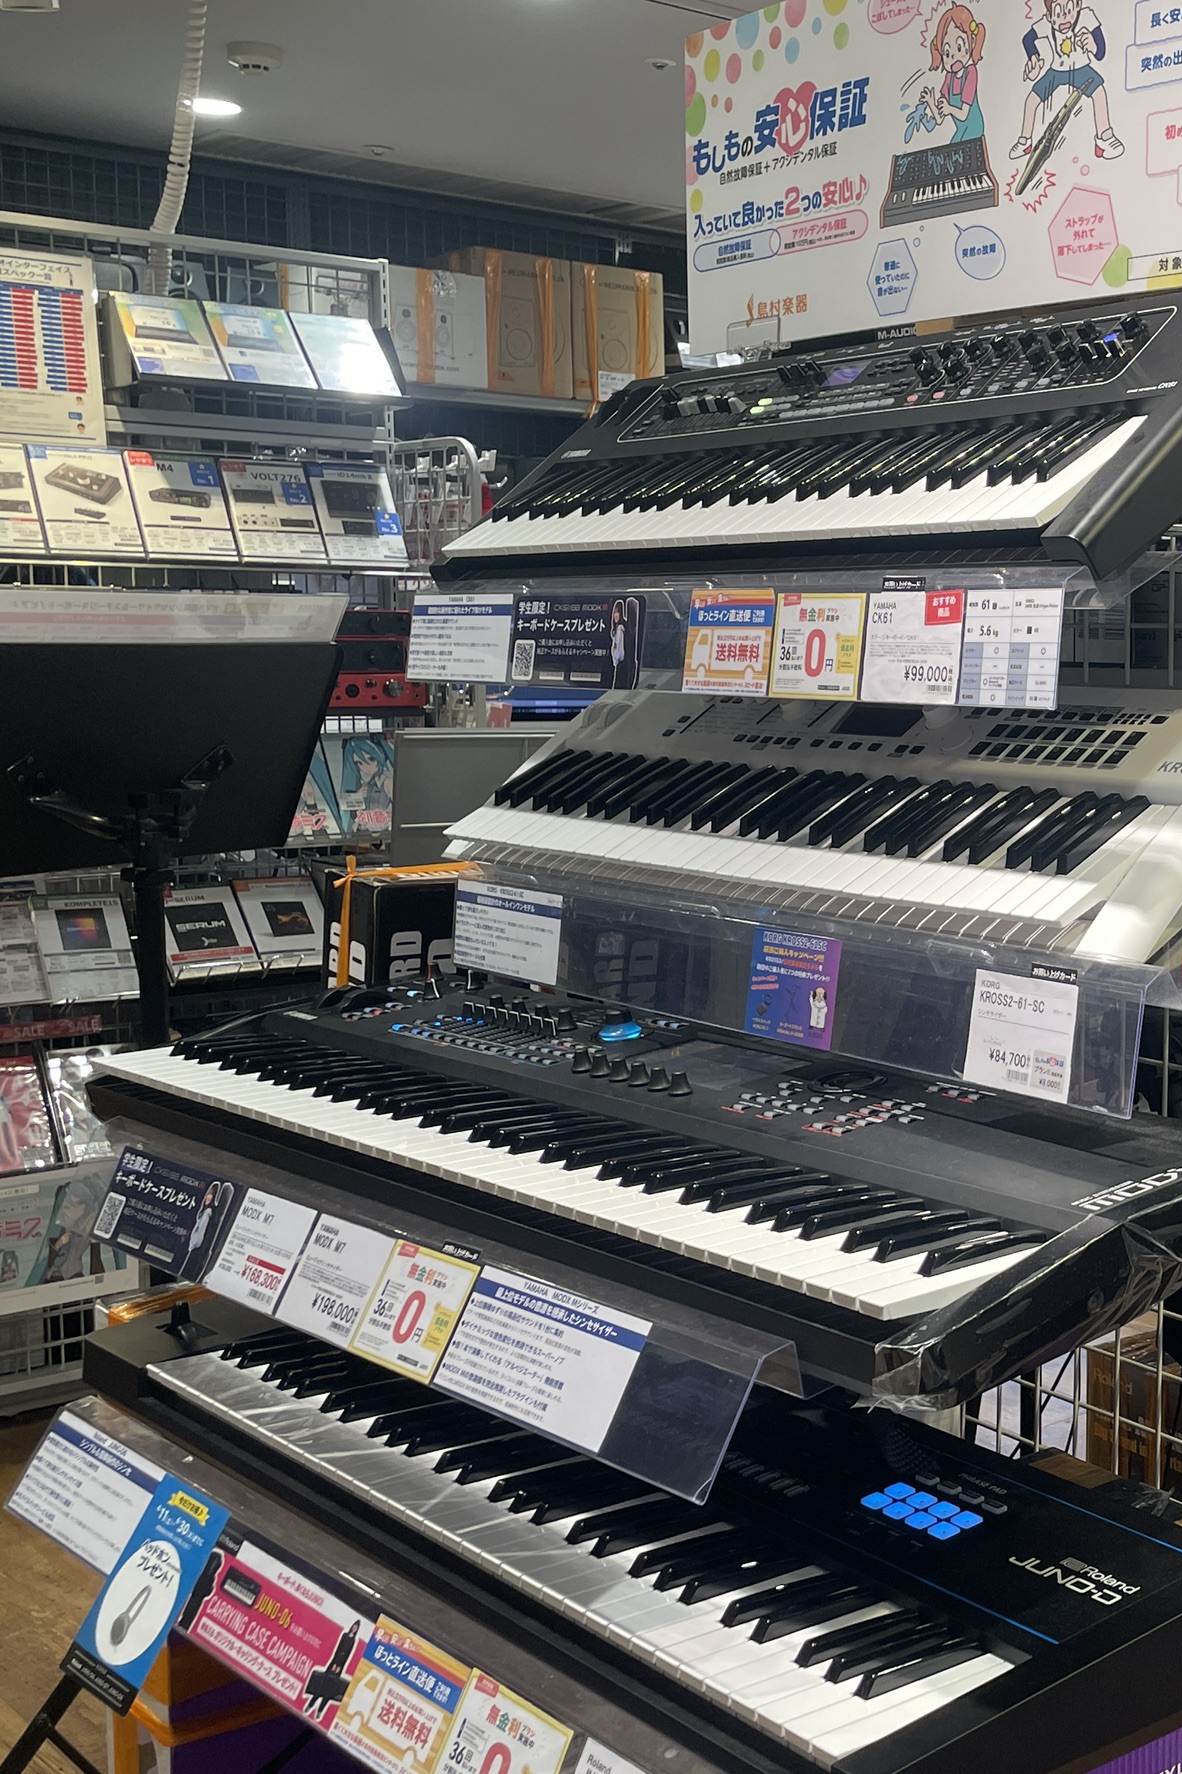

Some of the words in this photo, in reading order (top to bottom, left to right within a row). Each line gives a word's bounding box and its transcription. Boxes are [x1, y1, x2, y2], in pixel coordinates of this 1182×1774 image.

[693, 77, 870, 176] もしもの安心保証
[792, 218, 848, 239] アクシデンタル保証
[1065, 213, 1104, 229] ストラップが
[1072, 228, 1096, 242] 外れて
[962, 243, 996, 259] 突然の故障
[757, 293, 809, 318] 島村楽器
[156, 463, 174, 473] M4
[250, 471, 301, 483] VOLT276
[873, 602, 897, 610] YAMAHA
[932, 596, 956, 607] おすすめ
[698, 609, 752, 622] ほっとライン直送便
[799, 607, 827, 622] 無金利
[872, 611, 893, 624] CK61
[516, 618, 606, 632] キーボードケースプレゼント
[979, 625, 992, 637] 5.6
[715, 643, 760, 662] 送料無料
[175, 919, 227, 933] SERUM
[1032, 967, 1077, 982] お買い上げカード
[981, 979, 1001, 990] KORG
[979, 990, 1045, 1013] KROSS2-61-SC
[13, 1024, 45, 1039] SALE
[68, 1015, 102, 1032] SALE
[988, 1048, 1026, 1068] ¥84,700
[115, 1170, 196, 1210] キーボードケースプレゼント
[241, 1205, 262, 1222] MODX
[263, 1213, 275, 1226] M7
[313, 1232, 334, 1250] MODX
[334, 1239, 346, 1254] M7
[241, 1264, 279, 1291] ¥168,300
[406, 1262, 434, 1286] 無金利
[522, 1280, 549, 1297] YAMAHA
[311, 1292, 354, 1324] ¥198,000
[987, 1483, 1007, 1496] PAD
[1008, 1556, 1122, 1605] JUNO-D
[1080, 1565, 1141, 1595] Roland
[206, 1596, 250, 1635] CARRYING
[248, 1617, 272, 1650] CASE
[267, 1634, 314, 1680] CAMPAIGN
[374, 1645, 437, 1694] ほっとライン直送便
[377, 1697, 433, 1750] 送料無料
[485, 1703, 522, 1740] 無金利
[521, 1724, 536, 1738] プラン
